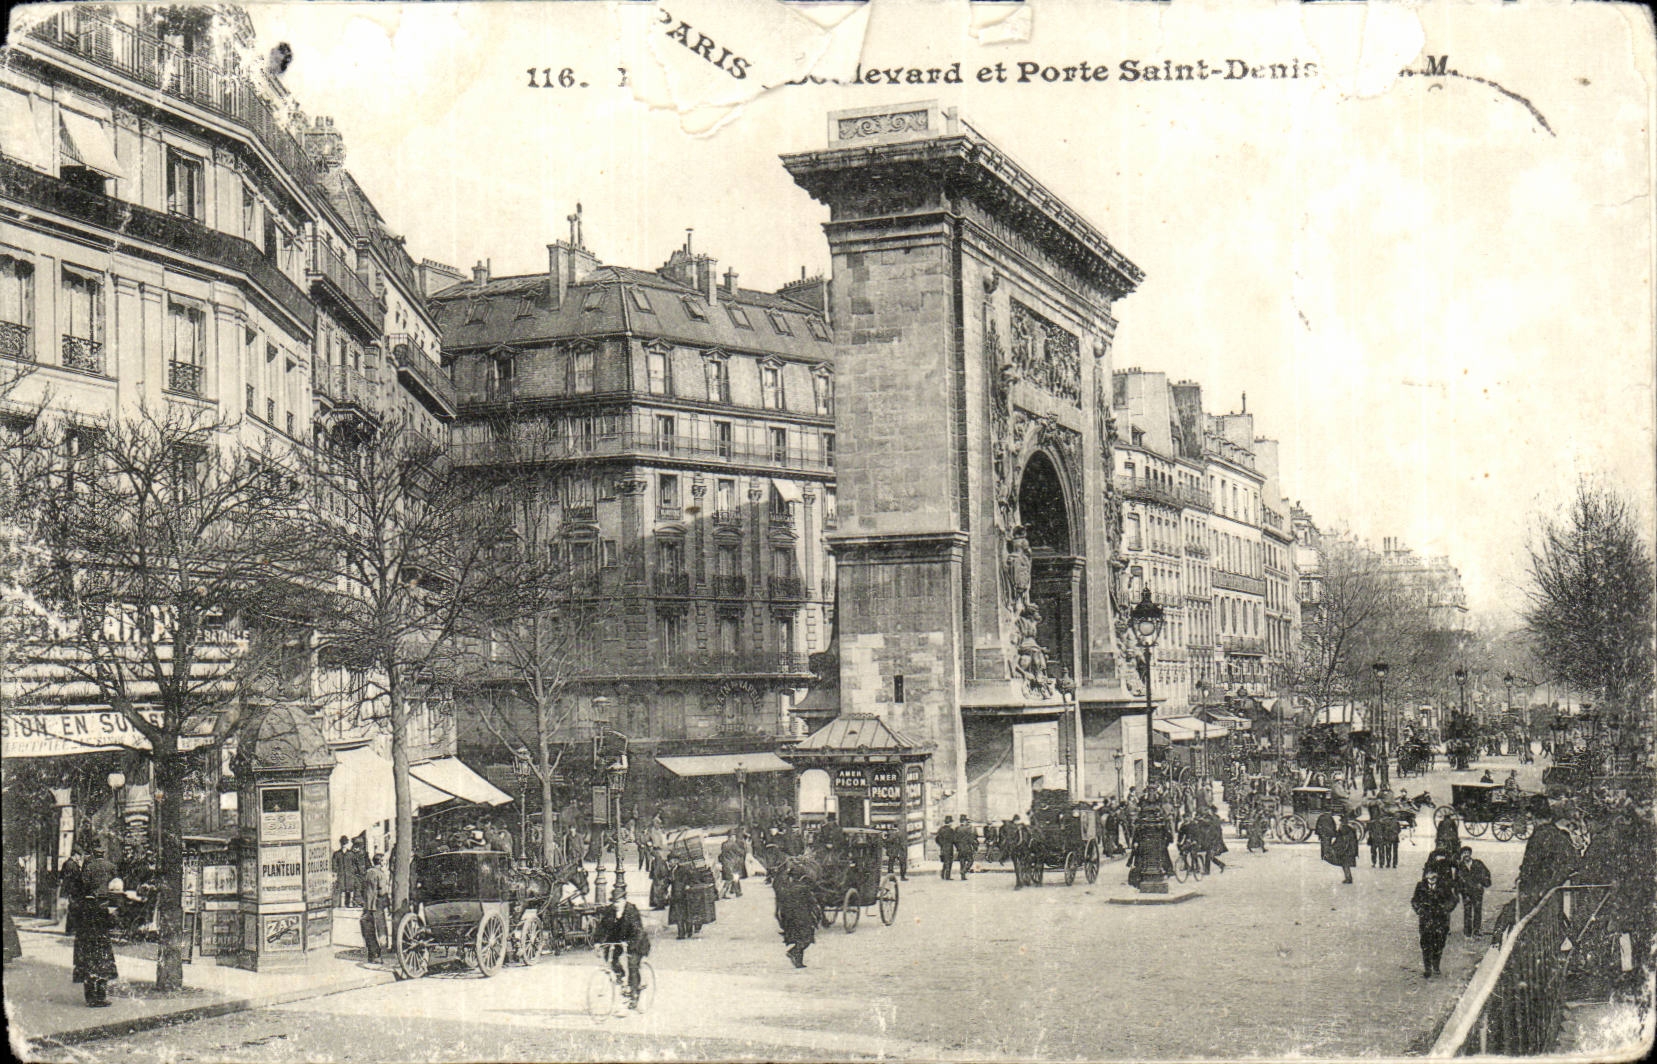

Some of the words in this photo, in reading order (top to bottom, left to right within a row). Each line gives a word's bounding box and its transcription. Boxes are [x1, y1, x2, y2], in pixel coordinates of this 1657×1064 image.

[62, 715, 89, 736] EN
[835, 778, 866, 786] PICON
[871, 786, 900, 798] PICON
[262, 863, 301, 877] PLANTEUR
